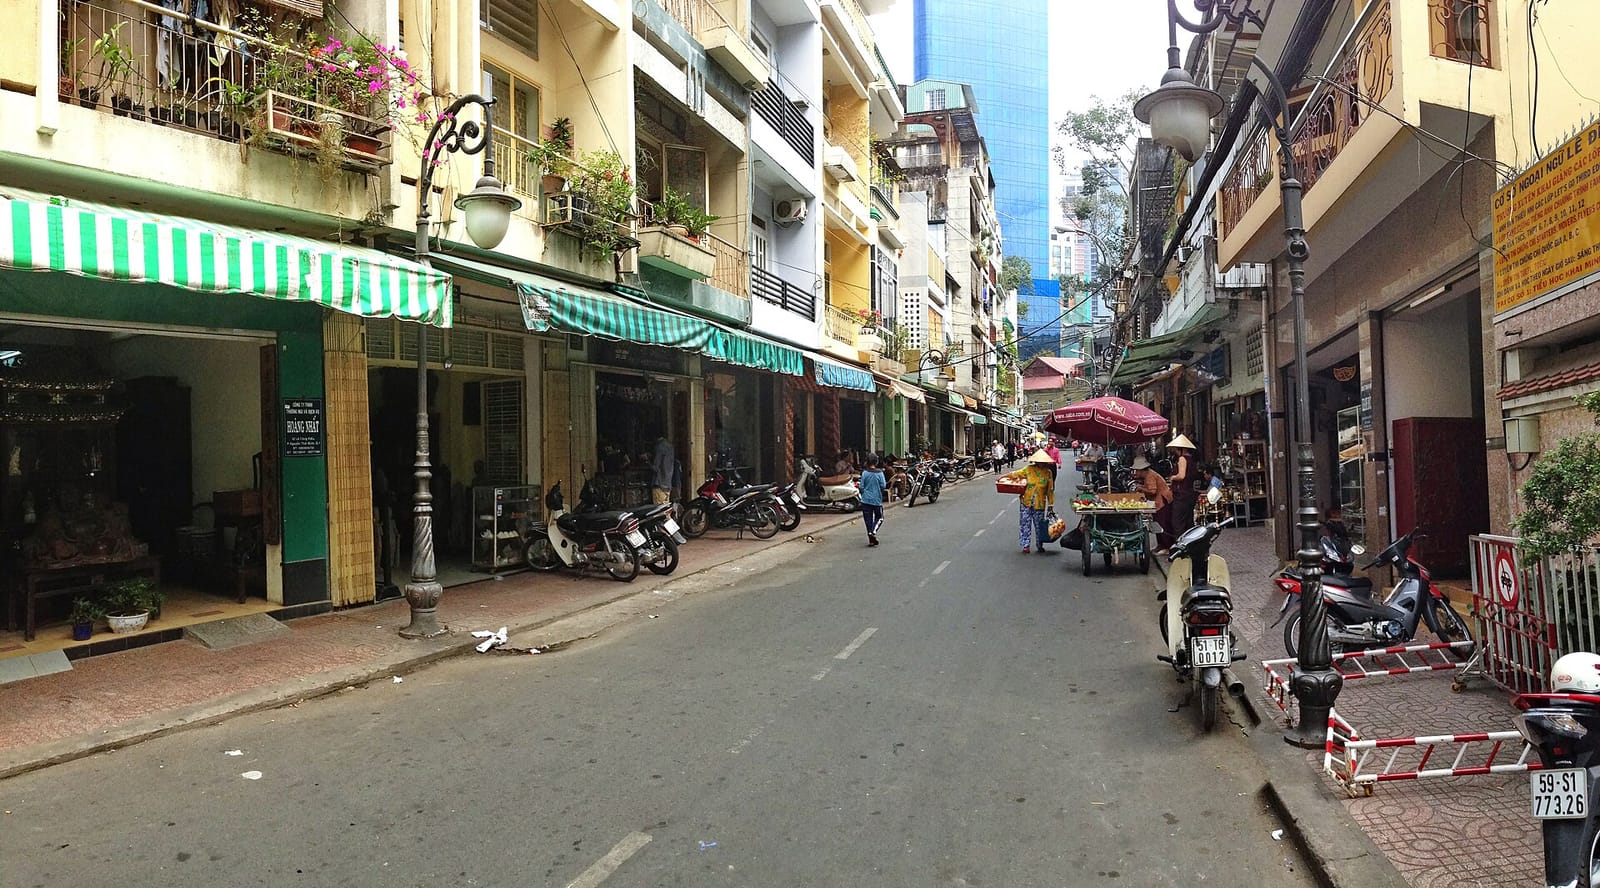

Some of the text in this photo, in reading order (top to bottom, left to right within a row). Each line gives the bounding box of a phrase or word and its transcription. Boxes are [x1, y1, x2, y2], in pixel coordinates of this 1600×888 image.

[1519, 167, 1543, 192] NGOẠI
[1567, 137, 1582, 160] LÊ
[287, 415, 319, 433] HOÀNG NHẤT
[1199, 652, 1224, 663] 0012
[1535, 794, 1583, 815] 773.26
